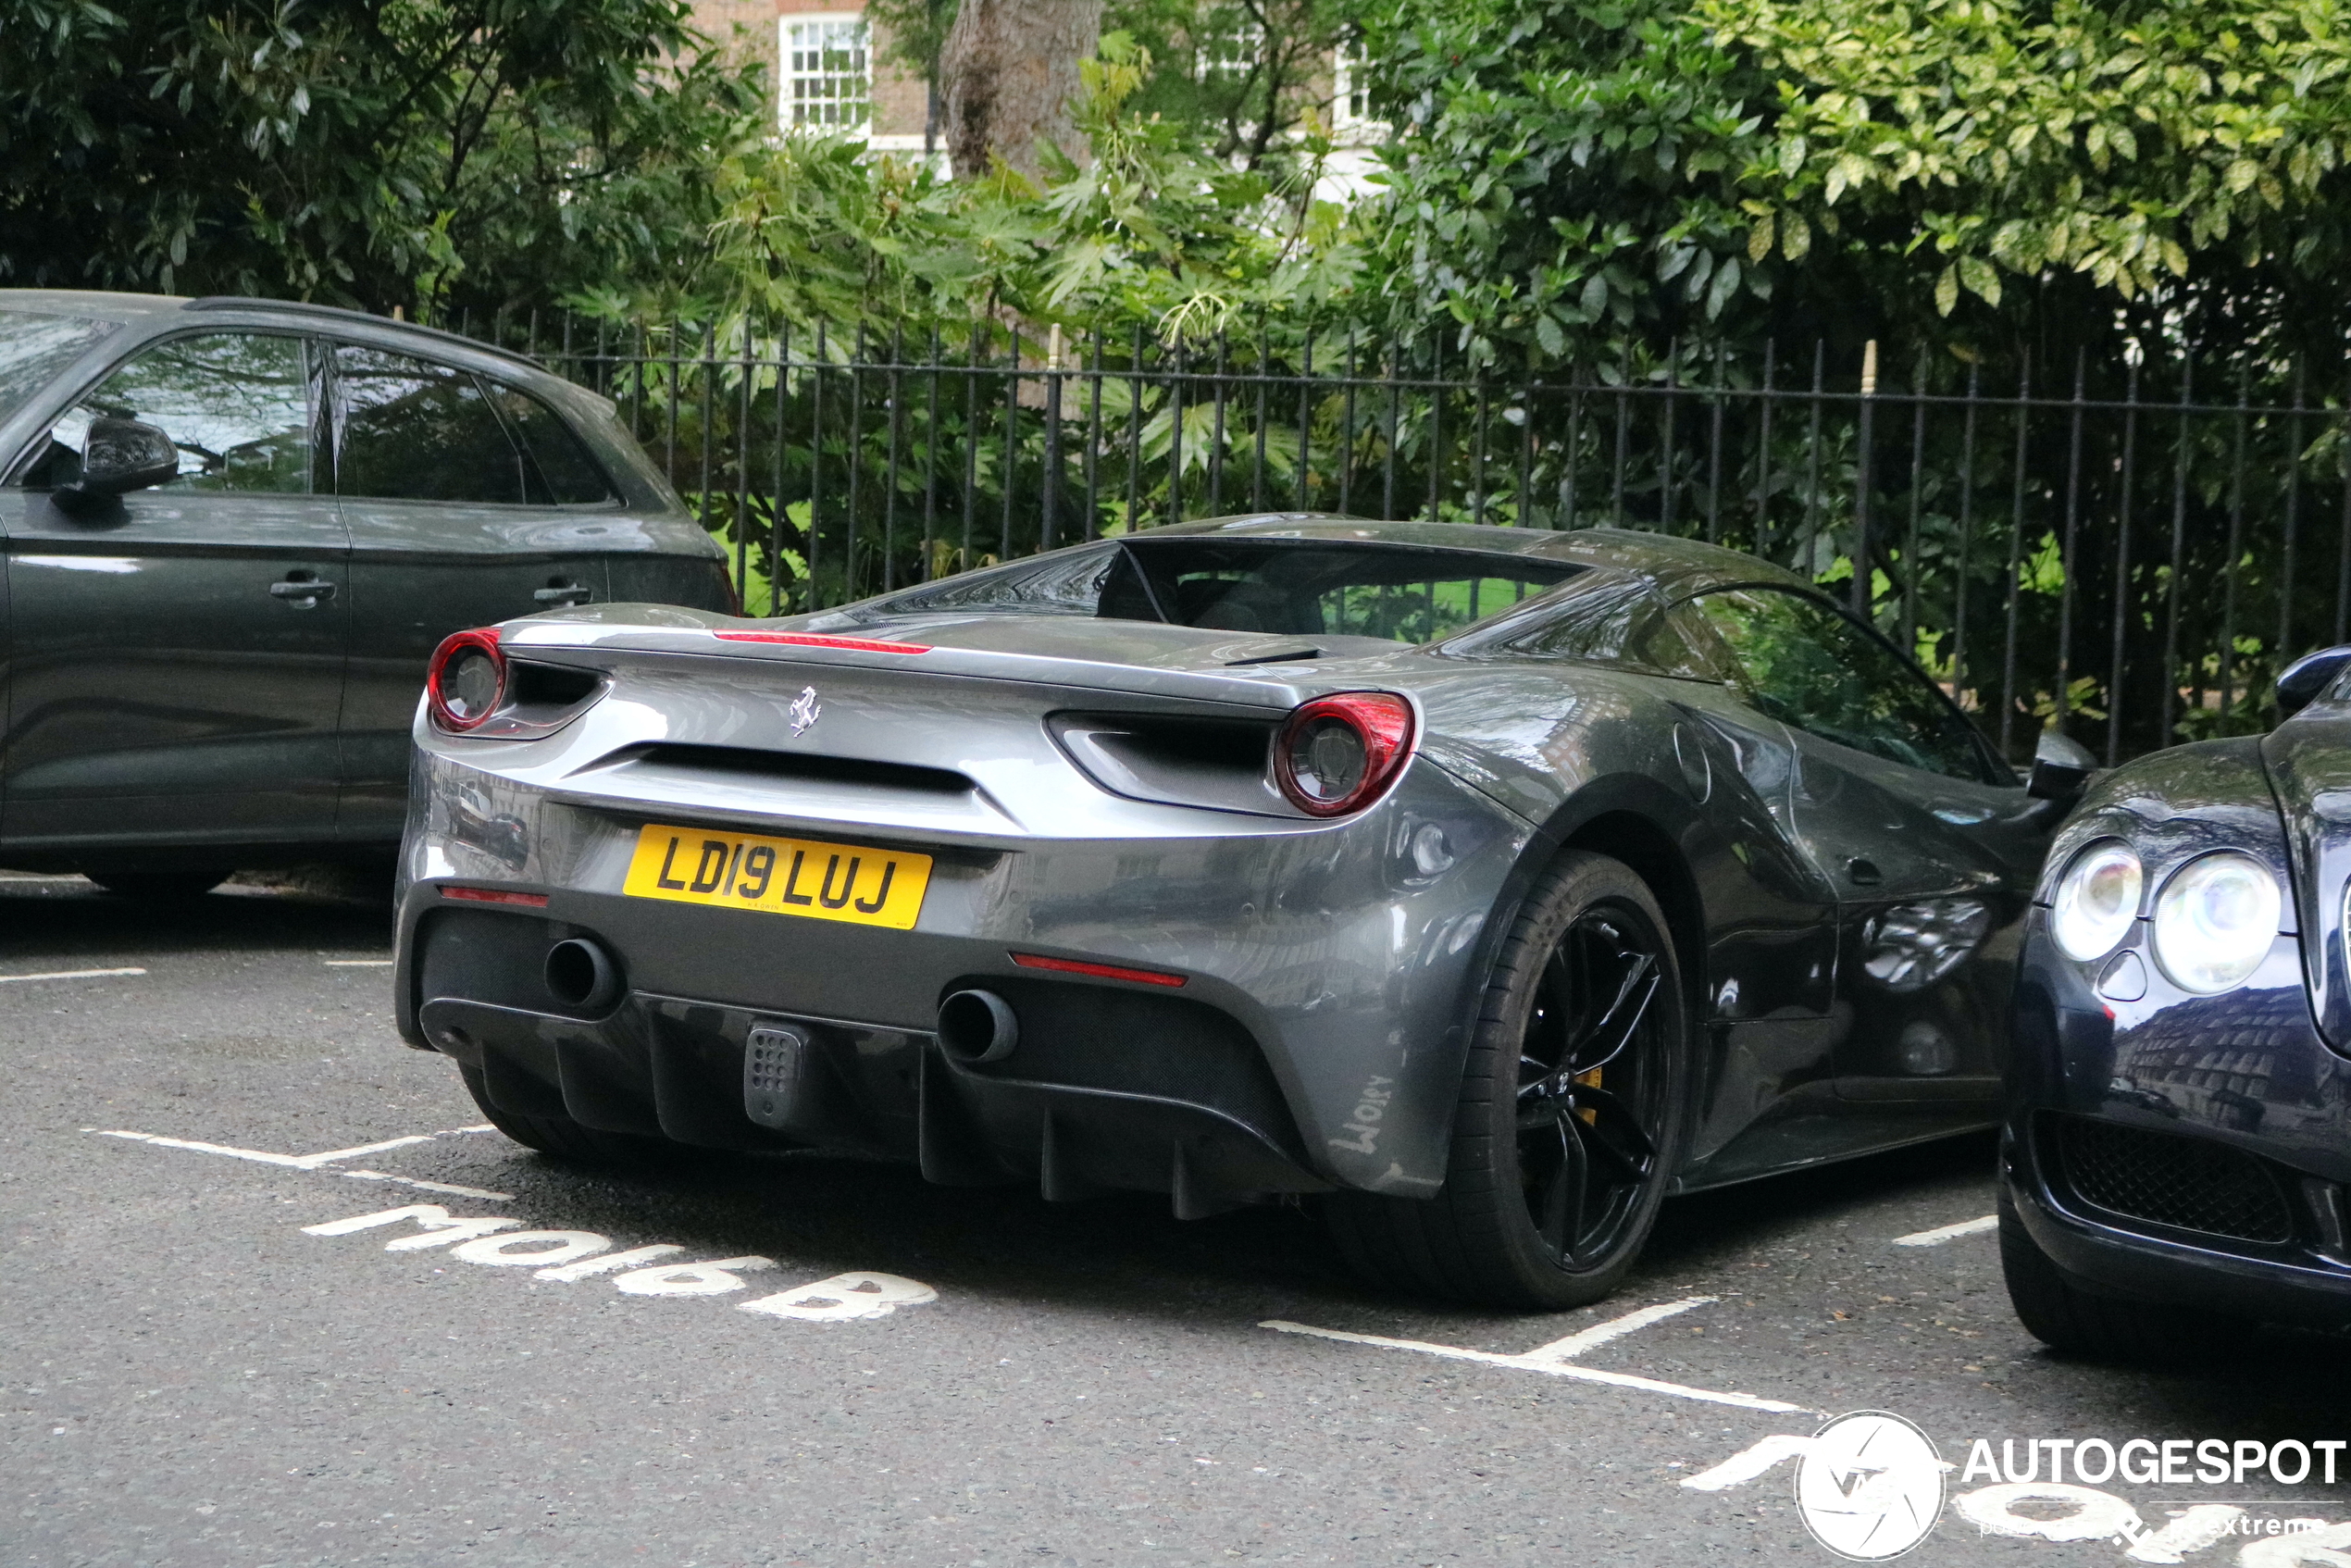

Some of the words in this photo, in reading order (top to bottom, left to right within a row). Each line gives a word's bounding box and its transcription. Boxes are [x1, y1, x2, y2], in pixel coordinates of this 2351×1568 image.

[657, 837, 776, 899] LD19
[782, 850, 897, 914] LUJ
[736, 1271, 939, 1322] B
